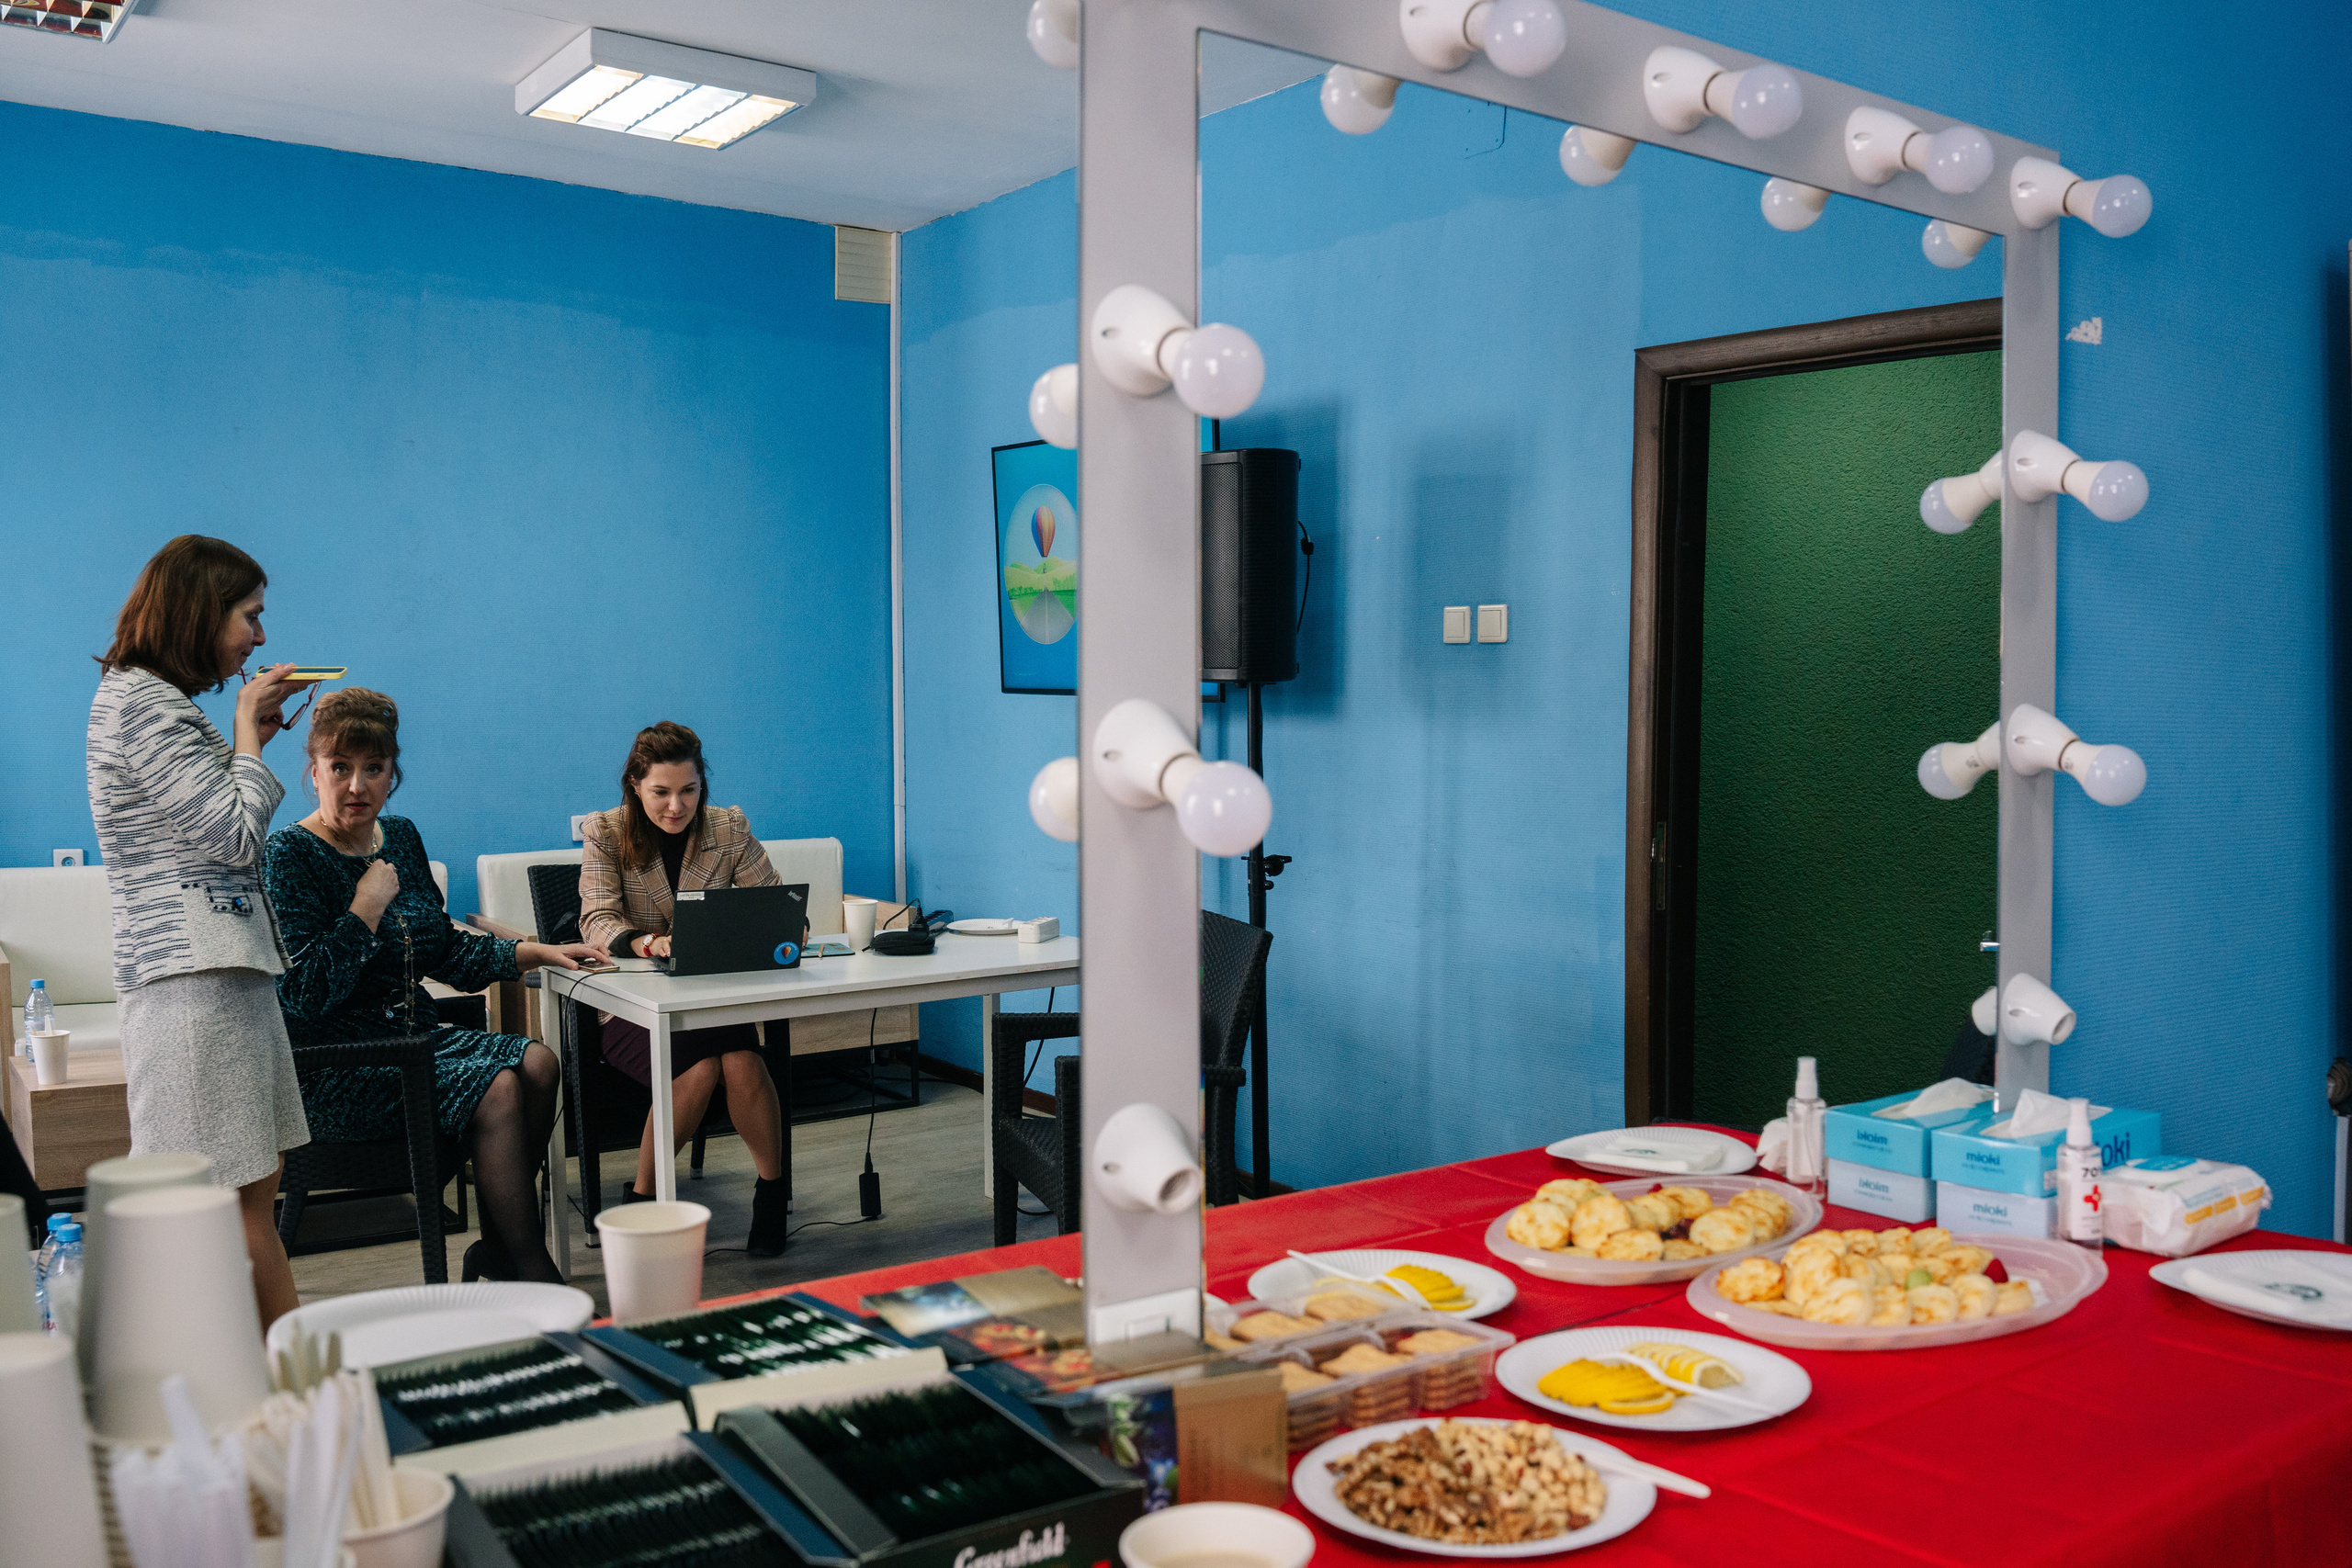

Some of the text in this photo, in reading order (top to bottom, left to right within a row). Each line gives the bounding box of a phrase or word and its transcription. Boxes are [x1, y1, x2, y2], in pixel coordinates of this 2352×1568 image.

[2095, 1132, 2131, 1167] oki
[1966, 1151, 2001, 1166] mioki
[1973, 1202, 2008, 1217] mioki
